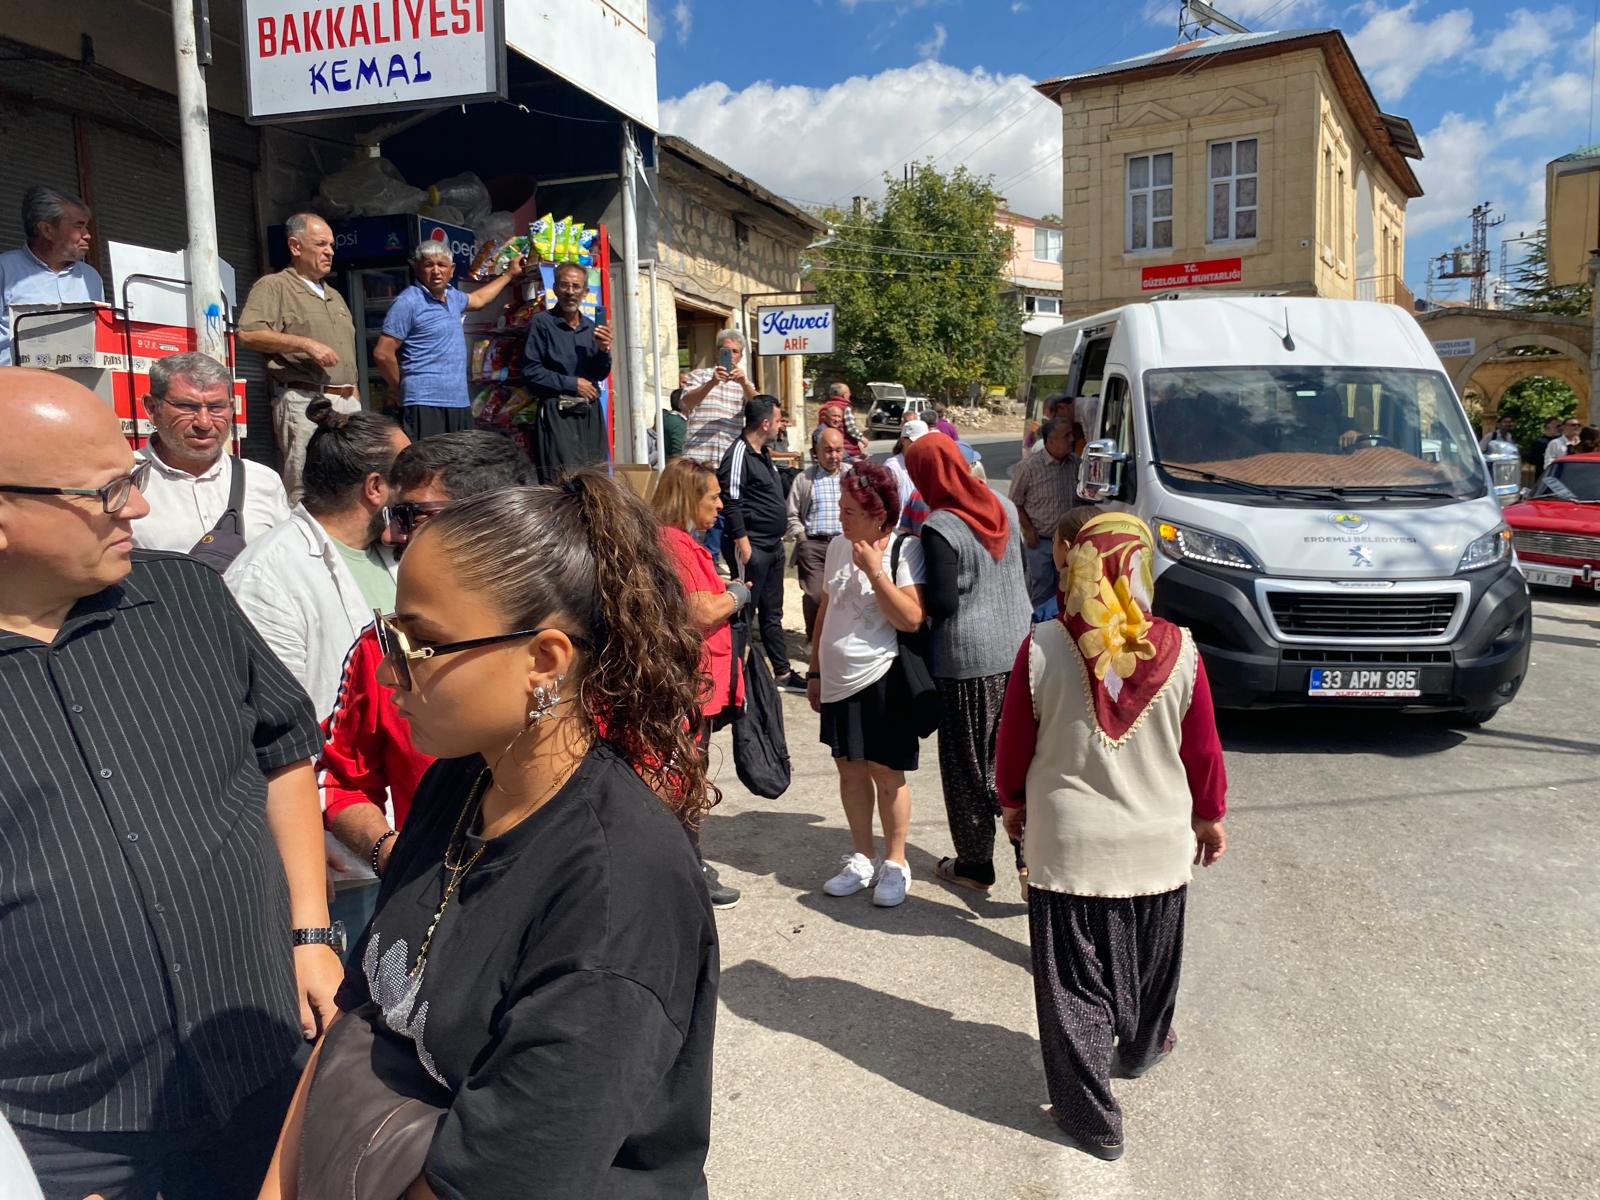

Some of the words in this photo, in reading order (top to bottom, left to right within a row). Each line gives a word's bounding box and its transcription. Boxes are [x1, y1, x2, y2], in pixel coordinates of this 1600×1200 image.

[309, 51, 432, 95] KEMAL
[335, 230, 358, 249] psi
[1143, 275, 1188, 287] GÜZELOLUK
[1191, 268, 1241, 283] MUHTARLIĞI
[1184, 264, 1199, 273] T.C.
[763, 310, 829, 335] Kahveci
[784, 336, 808, 350] ARİF
[1321, 670, 1342, 689] 33
[1349, 670, 1381, 689] APM
[1386, 670, 1417, 689] 985
